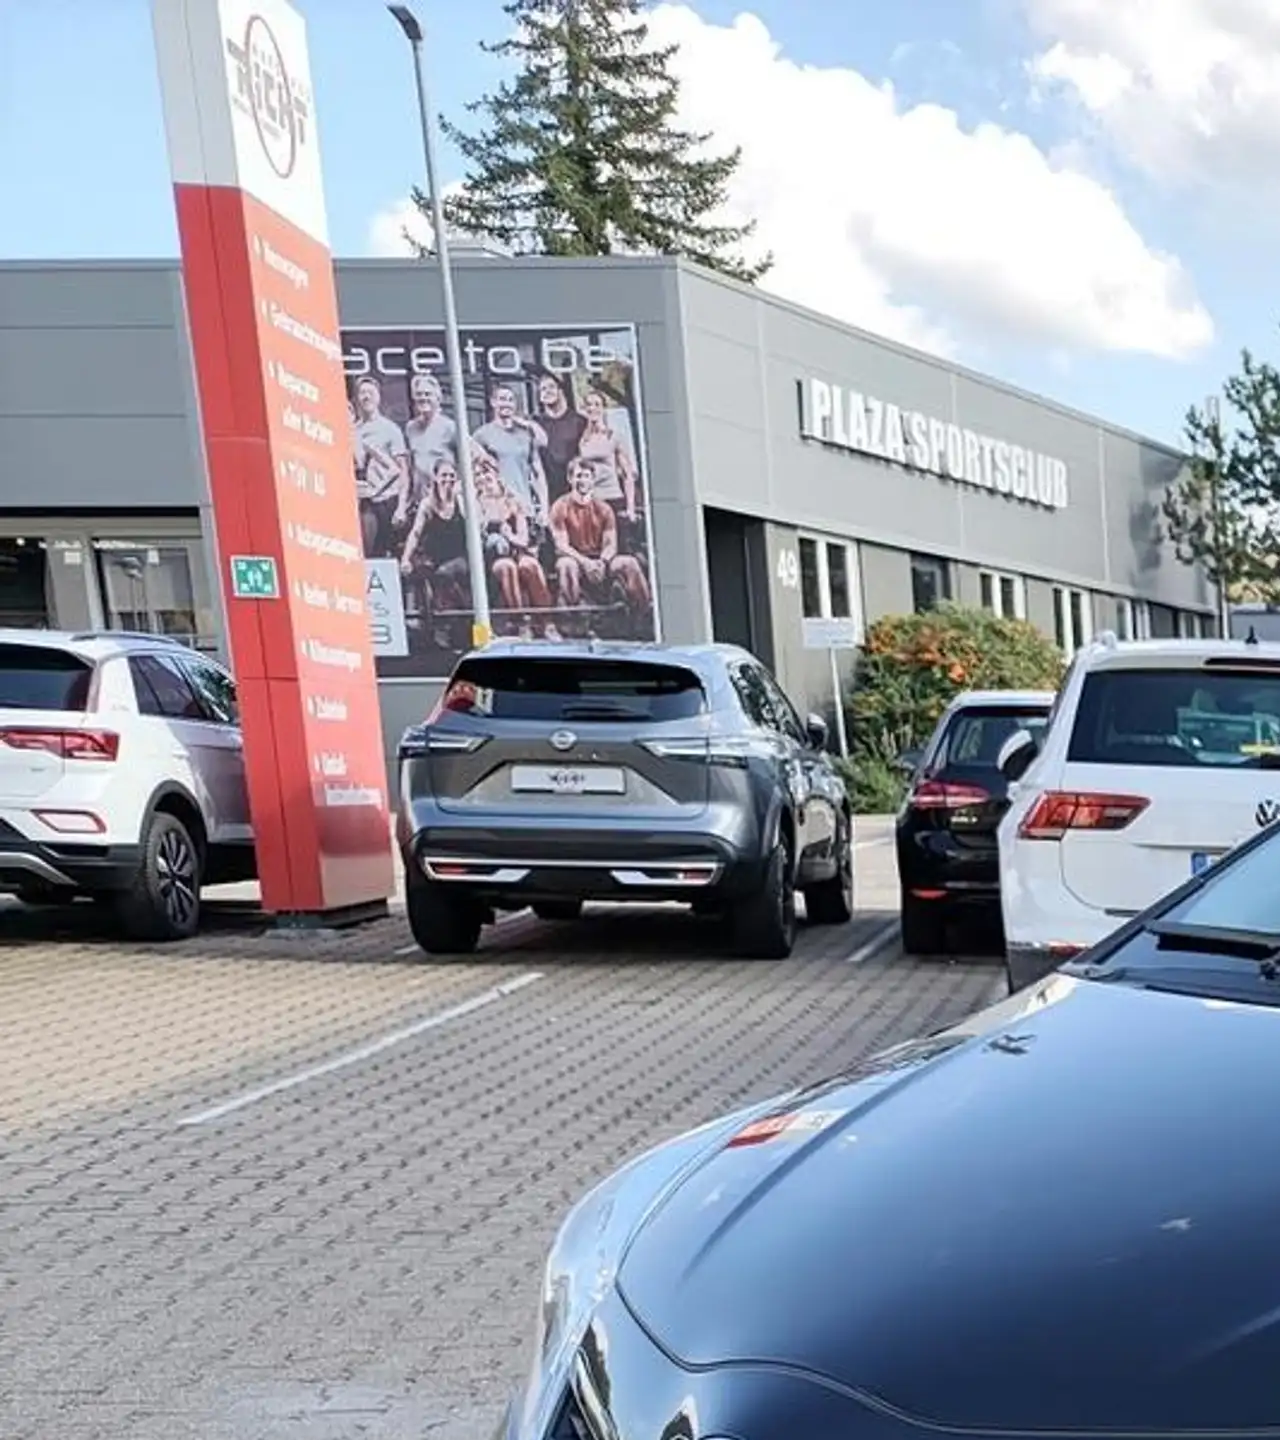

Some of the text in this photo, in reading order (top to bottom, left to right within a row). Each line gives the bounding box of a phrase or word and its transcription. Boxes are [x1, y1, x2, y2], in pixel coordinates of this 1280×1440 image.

[463, 338, 521, 374] to
[541, 338, 615, 373] be
[802, 377, 1067, 507] PLAZA SPORTSCLUB
[777, 547, 798, 588] 49
